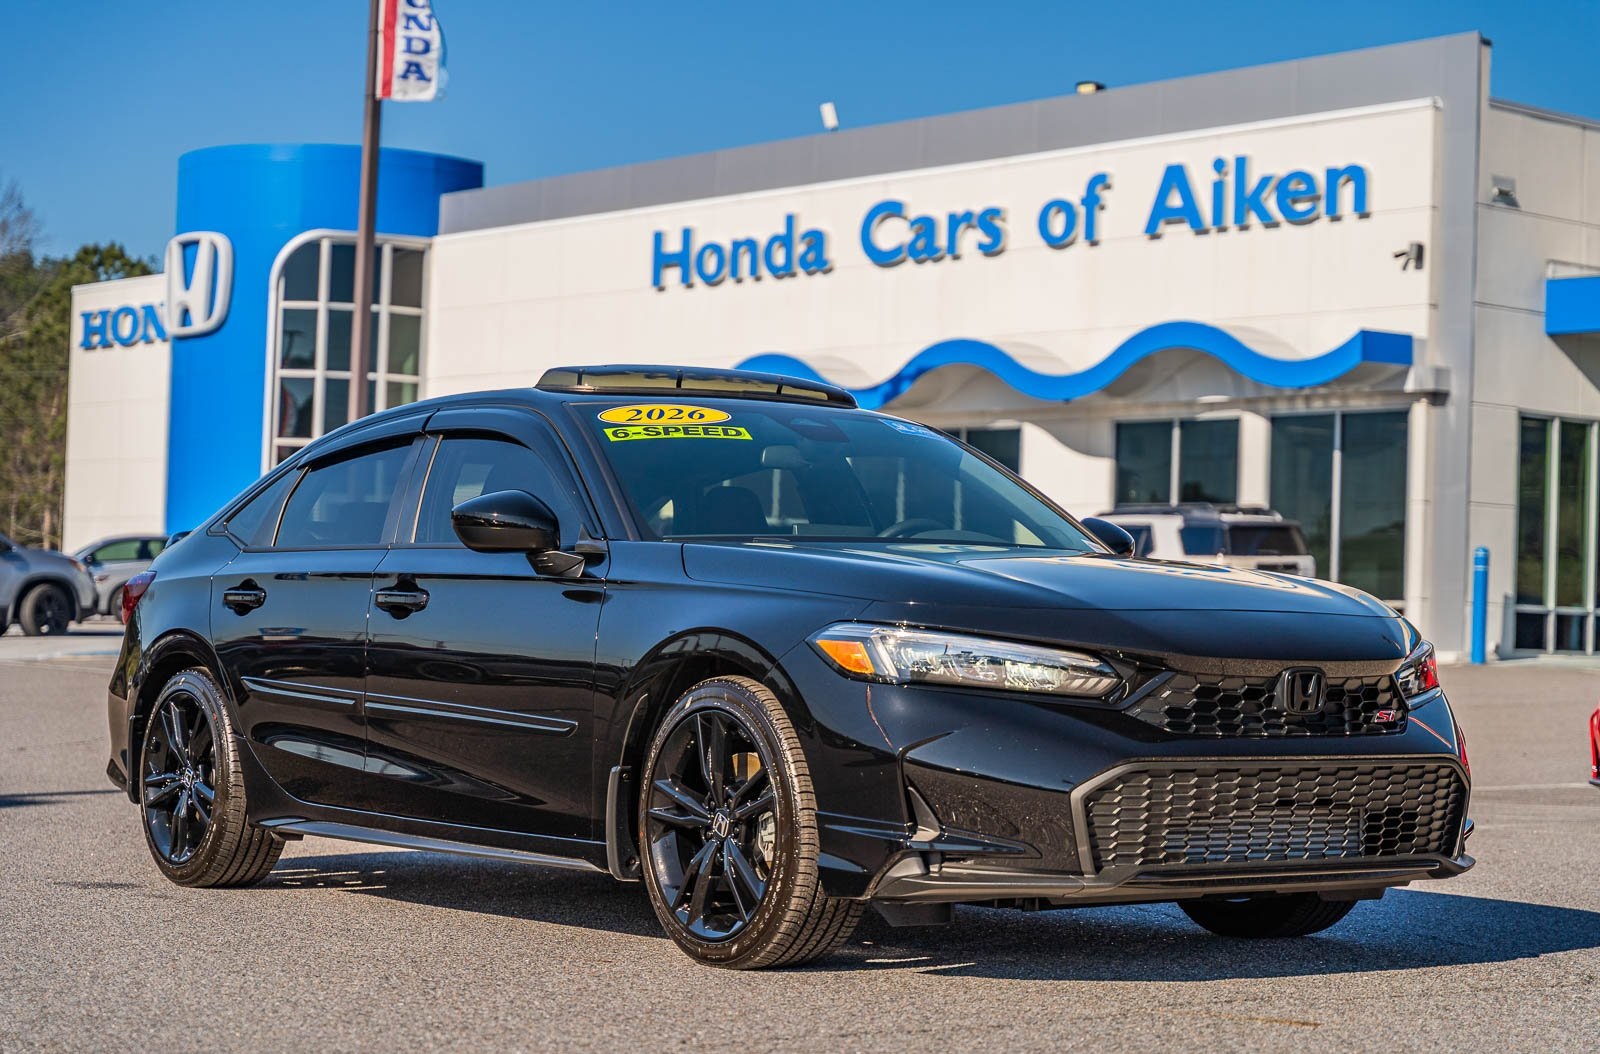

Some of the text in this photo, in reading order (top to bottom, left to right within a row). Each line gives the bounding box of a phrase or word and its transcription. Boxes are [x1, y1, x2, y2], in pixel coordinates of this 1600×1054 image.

[652, 155, 1368, 289] Honda Cars of Aiken
[625, 407, 705, 422] 2026
[611, 426, 743, 439] 6-SPEED
